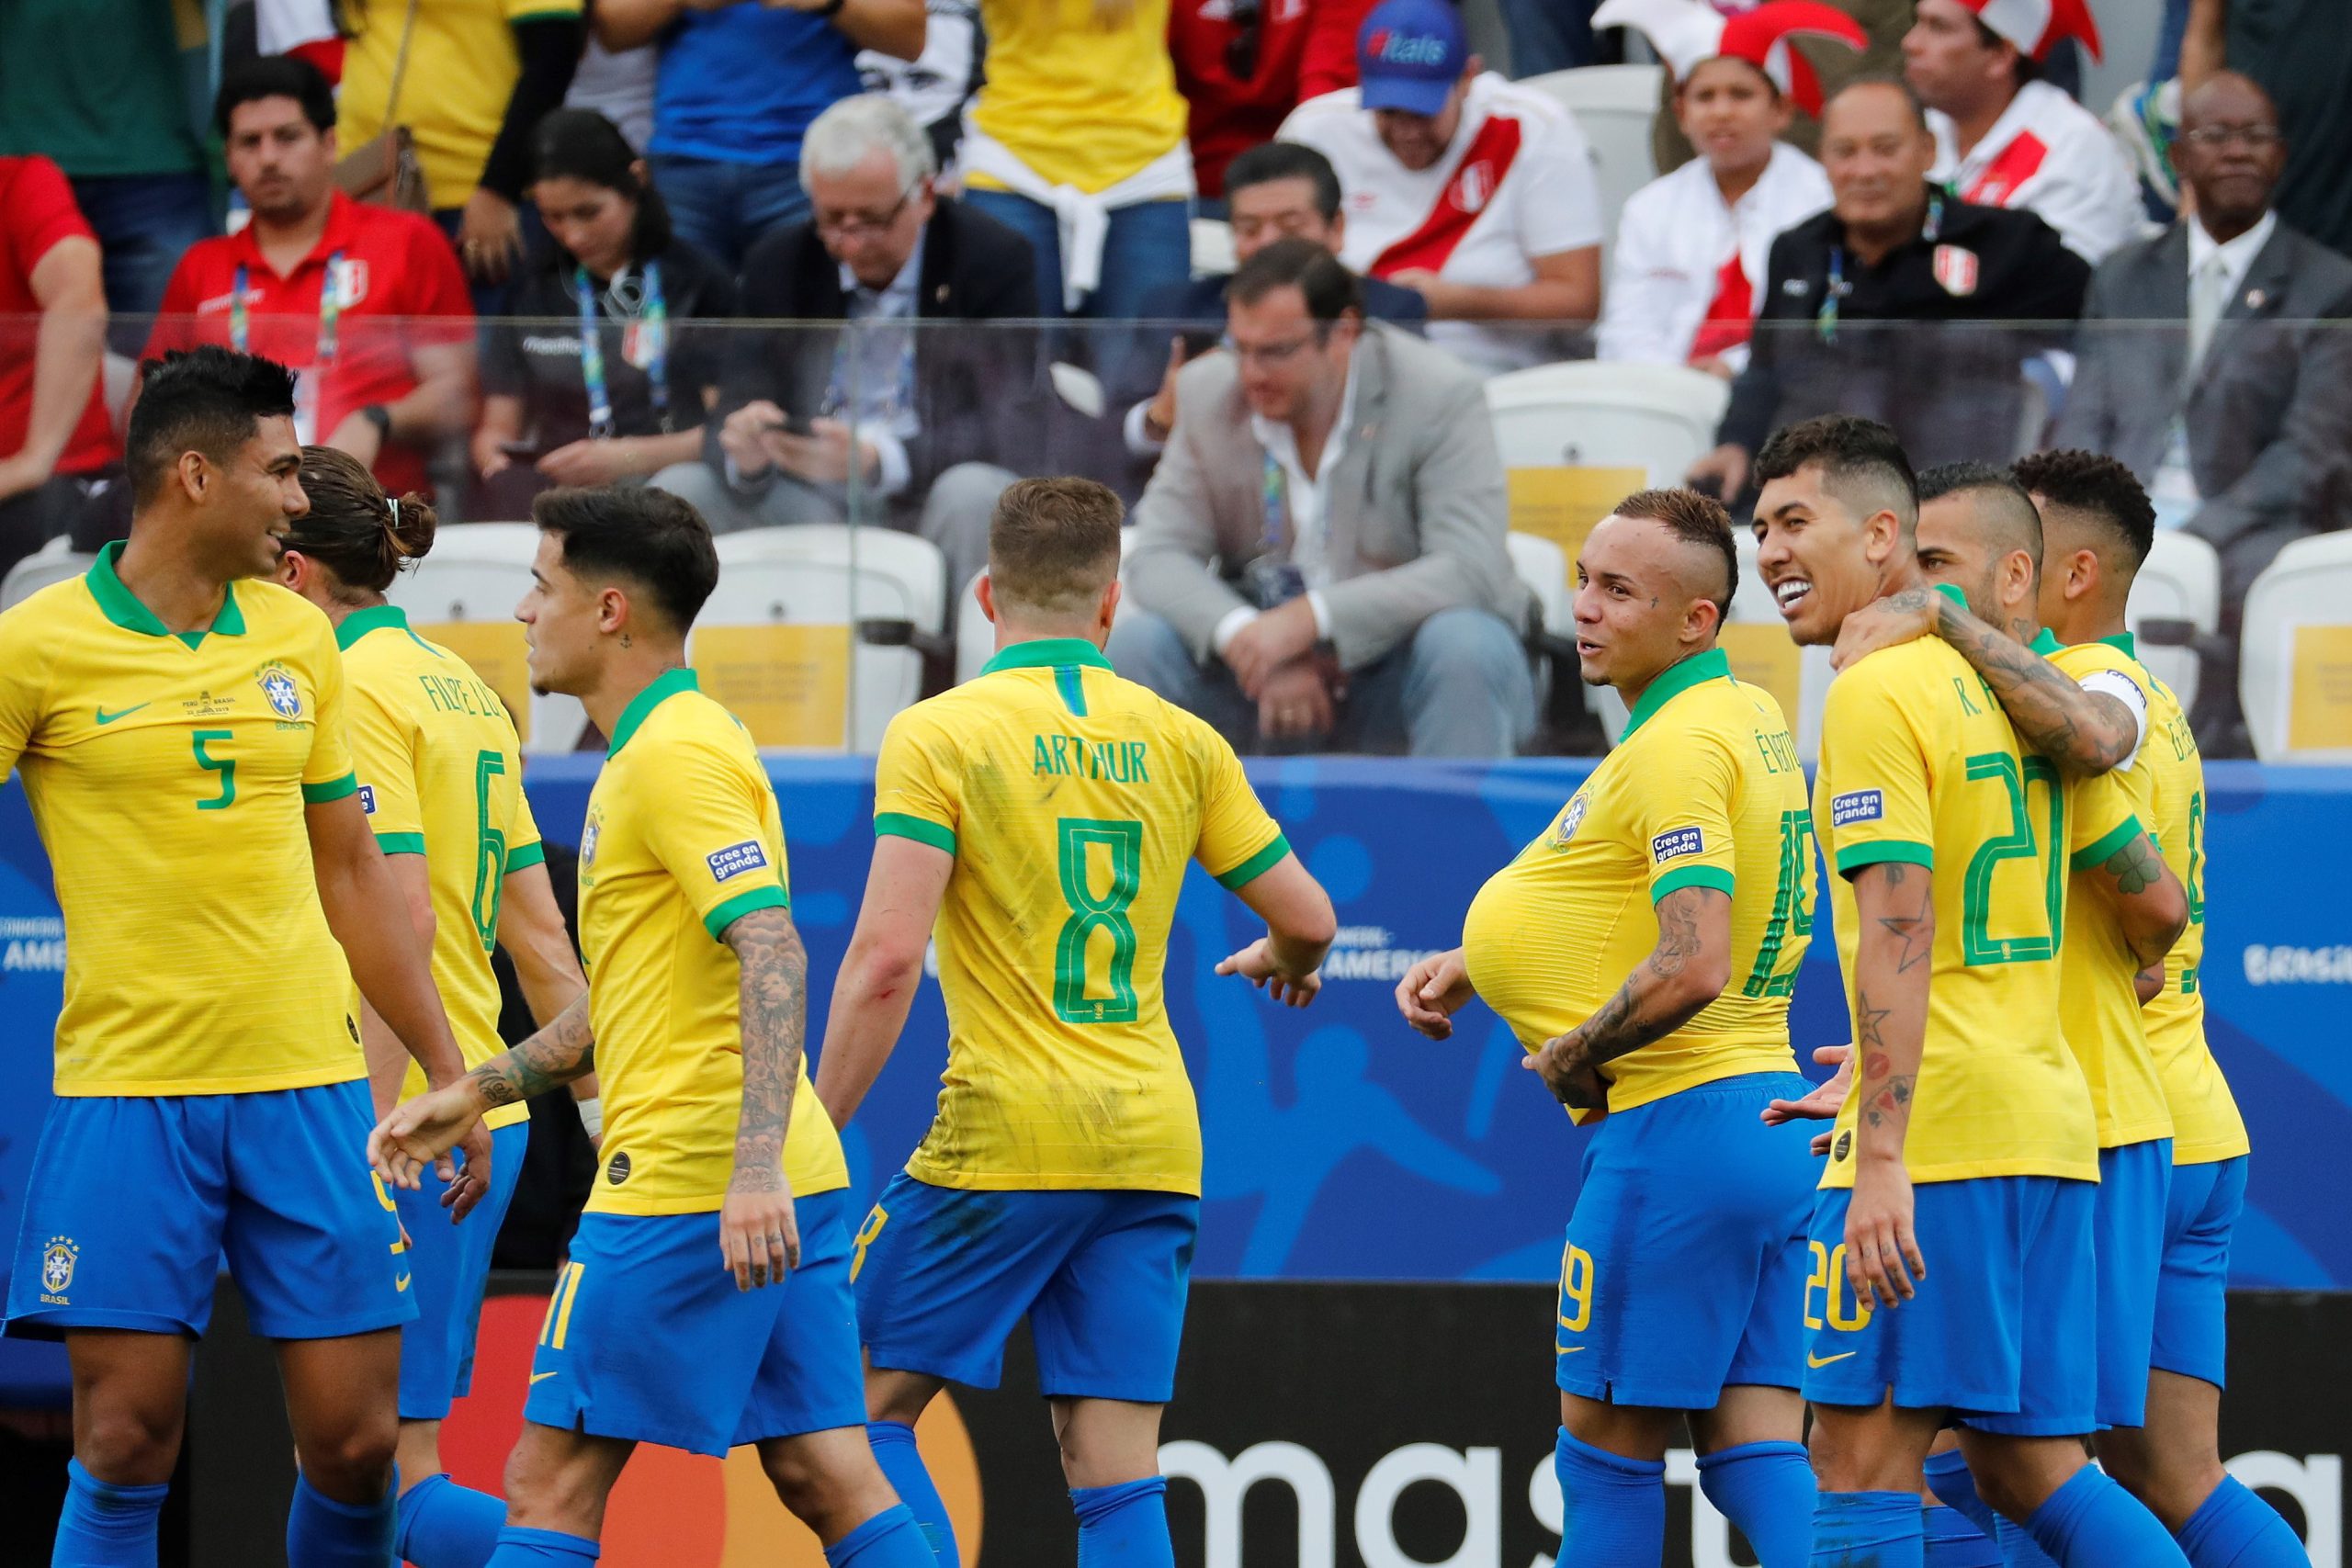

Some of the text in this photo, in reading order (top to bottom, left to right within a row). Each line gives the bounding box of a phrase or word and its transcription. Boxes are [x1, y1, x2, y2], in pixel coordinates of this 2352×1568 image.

[276, 720, 306, 730] BRASIL
[192, 729, 236, 809] 5
[1034, 734, 1150, 783] ARTHUR
[1834, 795, 1878, 811] Cree en
[1834, 804, 1876, 825] grande
[471, 749, 506, 952] 6
[709, 844, 758, 866] Cree en
[1654, 831, 1698, 851] Cree en
[1657, 841, 1698, 863] grande
[716, 852, 761, 878] grande
[1962, 750, 2064, 967] 20
[1052, 817, 1143, 1024] 8
[4, 940, 66, 971] AME
[40, 1293, 71, 1305] BRASIL
[1804, 1240, 1871, 1332] 20
[539, 1261, 585, 1349] 11
